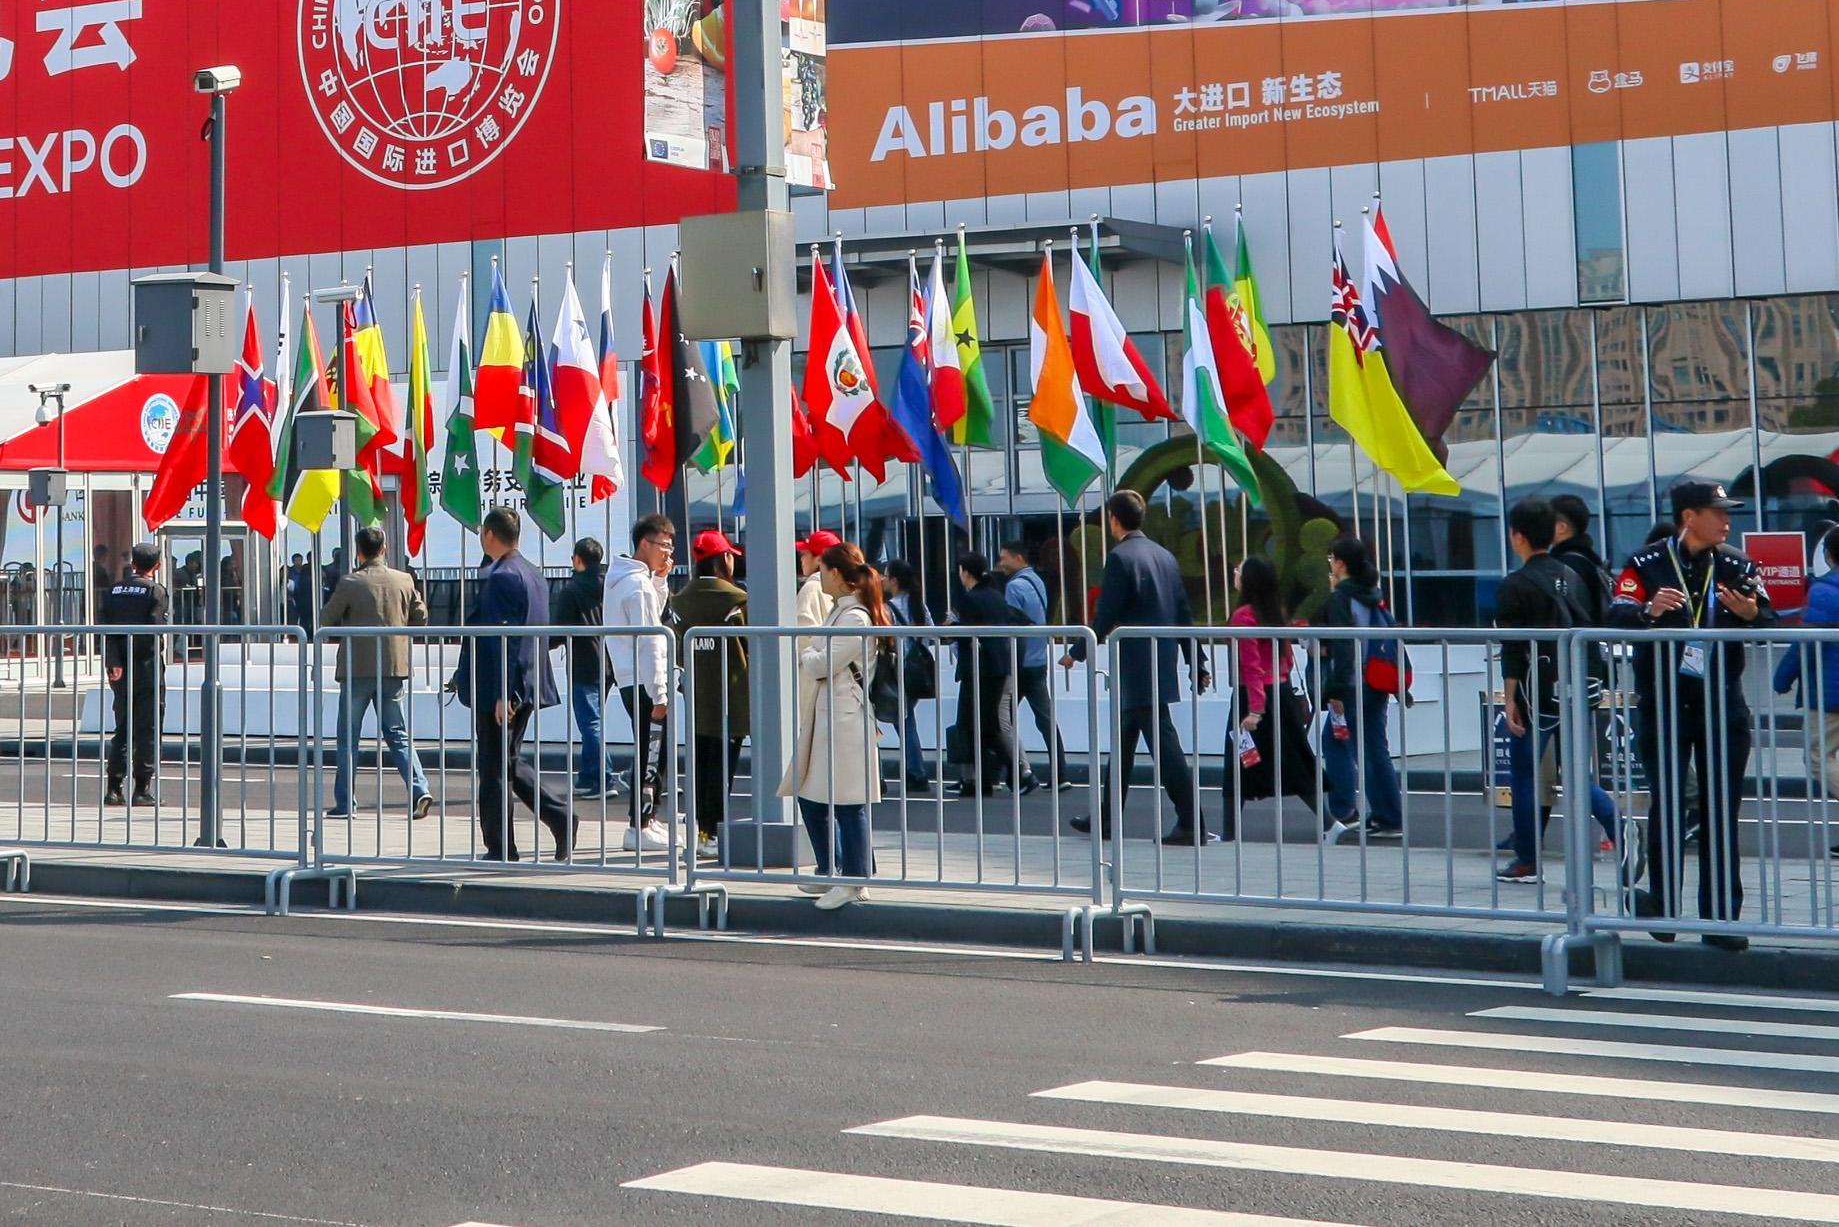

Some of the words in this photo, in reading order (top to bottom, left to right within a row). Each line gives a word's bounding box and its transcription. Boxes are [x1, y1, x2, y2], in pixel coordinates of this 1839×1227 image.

[1173, 81, 1251, 116] 大进口
[1261, 70, 1344, 107] 新生态
[869, 86, 1158, 162] Alibaba
[1173, 115, 1221, 133] Greater
[1225, 110, 1270, 129] Import
[1273, 107, 1303, 123] New
[1306, 100, 1380, 120] Ecosystem
